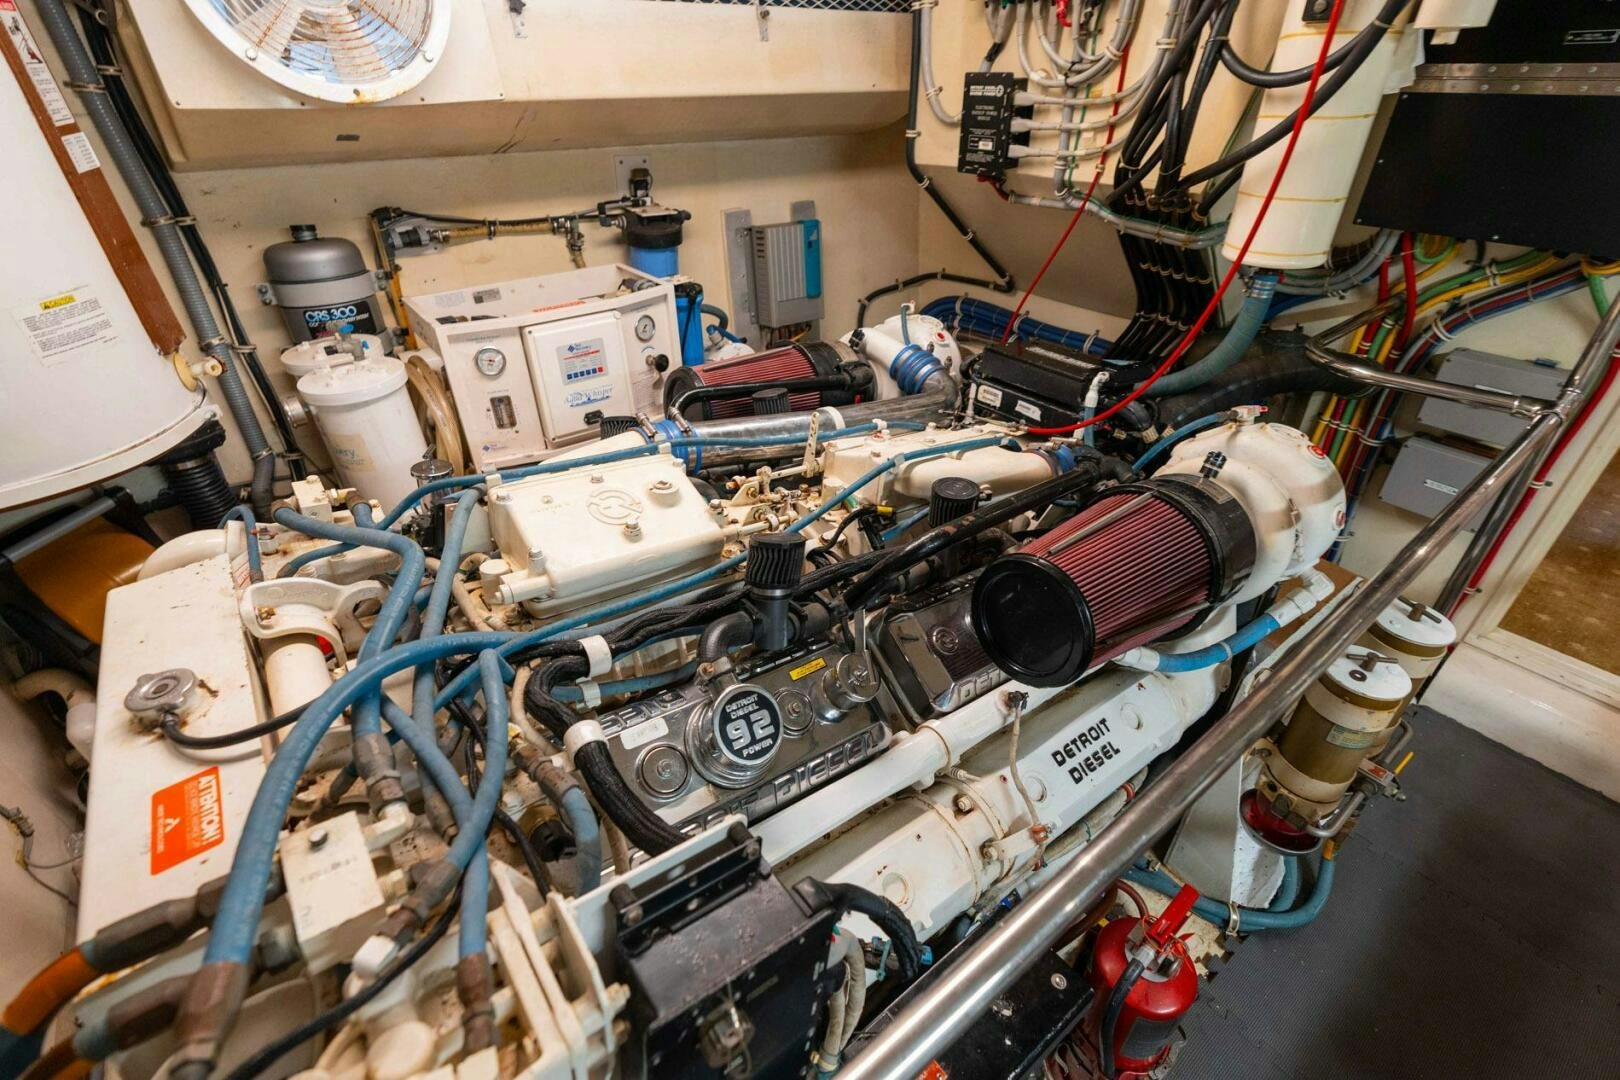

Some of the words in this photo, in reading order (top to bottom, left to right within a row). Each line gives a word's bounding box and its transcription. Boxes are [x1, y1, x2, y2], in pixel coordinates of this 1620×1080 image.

[331, 306, 357, 320] 300
[725, 693, 759, 712] DETROIT
[730, 703, 760, 719] DIESEL
[726, 709, 775, 750] 92
[1051, 718, 1110, 767] DETROIT
[742, 738, 773, 757] POWER
[773, 725, 884, 806] DIESEL
[1068, 742, 1120, 784] DIESEL
